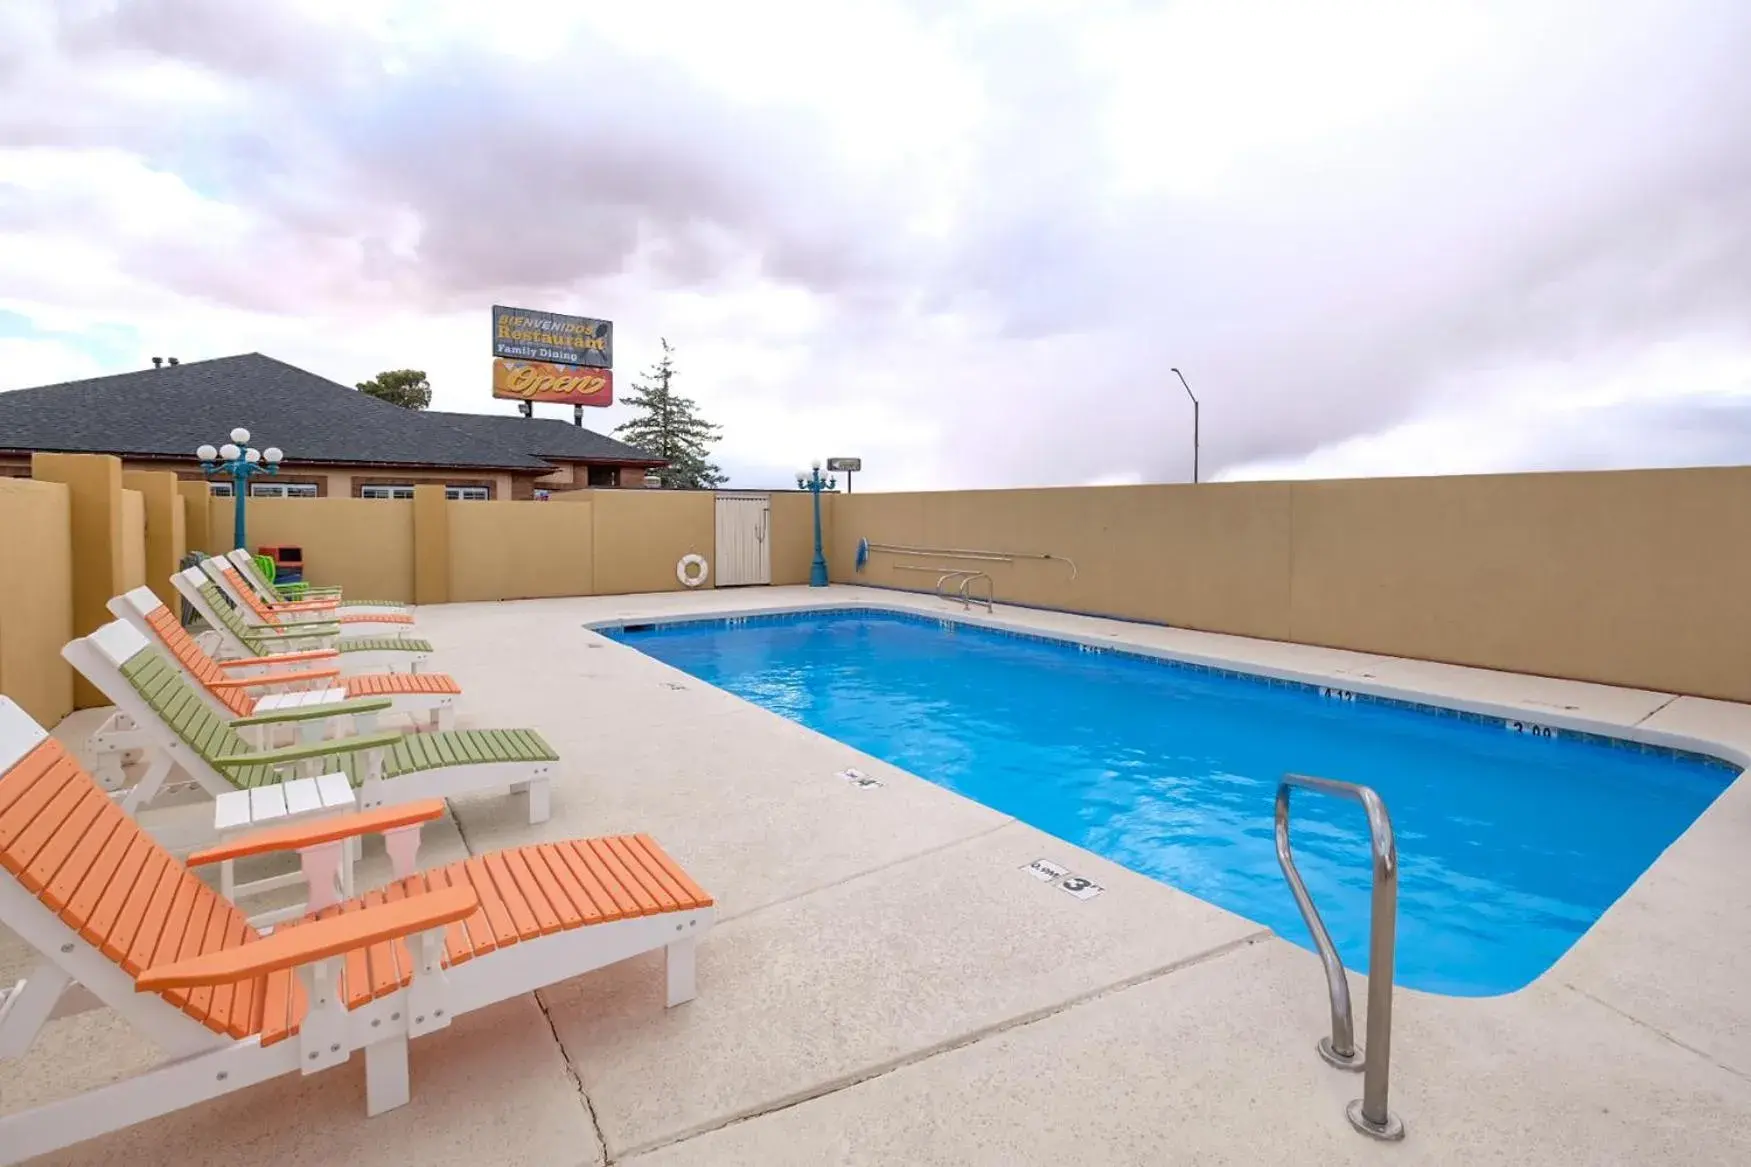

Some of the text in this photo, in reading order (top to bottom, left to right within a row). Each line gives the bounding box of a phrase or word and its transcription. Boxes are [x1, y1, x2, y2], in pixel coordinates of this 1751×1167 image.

[499, 315, 593, 335] BIENVENIDOS
[498, 325, 606, 350] Restaurant
[497, 344, 578, 361] Family Dining
[507, 365, 606, 397] Open
